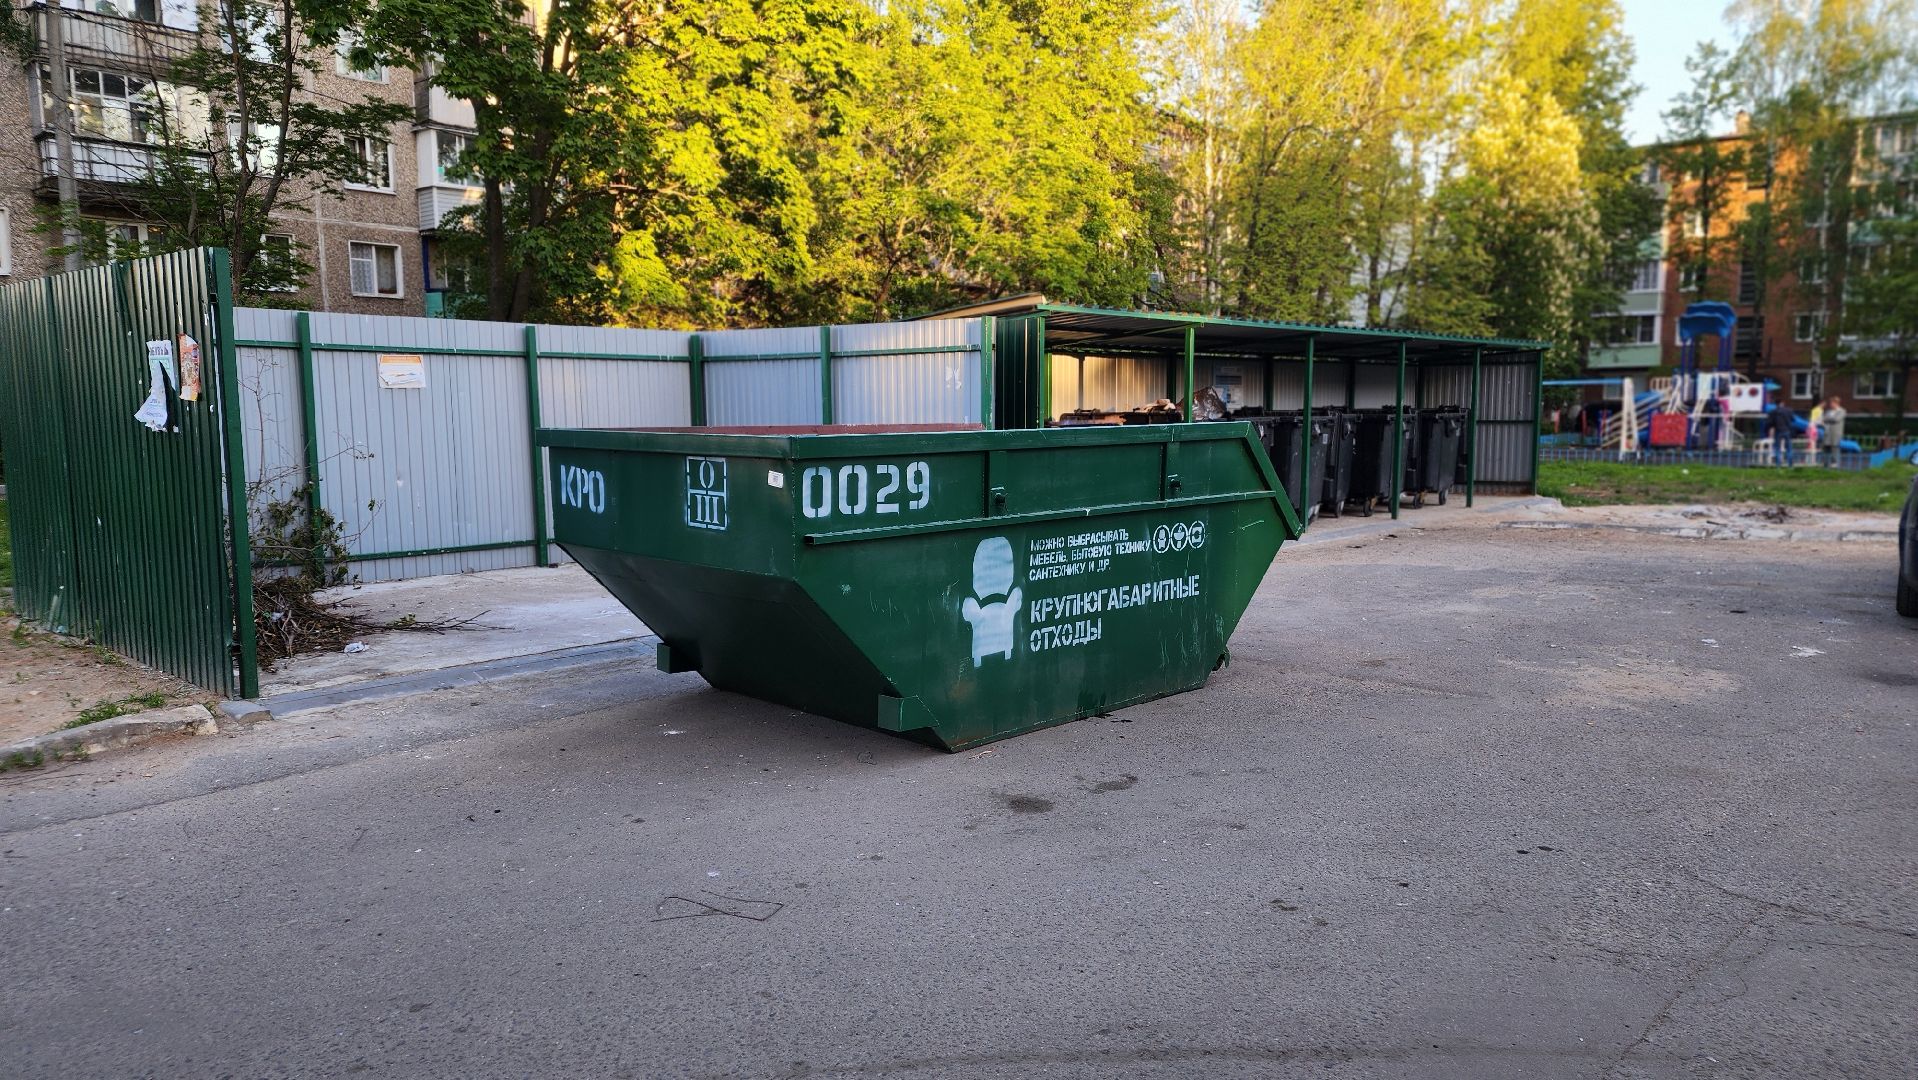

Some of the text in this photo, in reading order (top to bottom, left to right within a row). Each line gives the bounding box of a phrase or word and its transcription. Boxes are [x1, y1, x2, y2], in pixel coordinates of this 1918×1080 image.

[802, 461, 931, 518] 0029
[1030, 528, 1129, 551] МОЖНО ВЫБРАСЫВАТЬ
[1071, 544, 1112, 561] БЫТОВУЮ
[1029, 558, 1111, 581] САНТЕХНИКУ И ДР.
[1030, 574, 1200, 624] КРУПНОГАБАРИТНЫЕ
[1030, 617, 1102, 653] ОТХОДЫ
